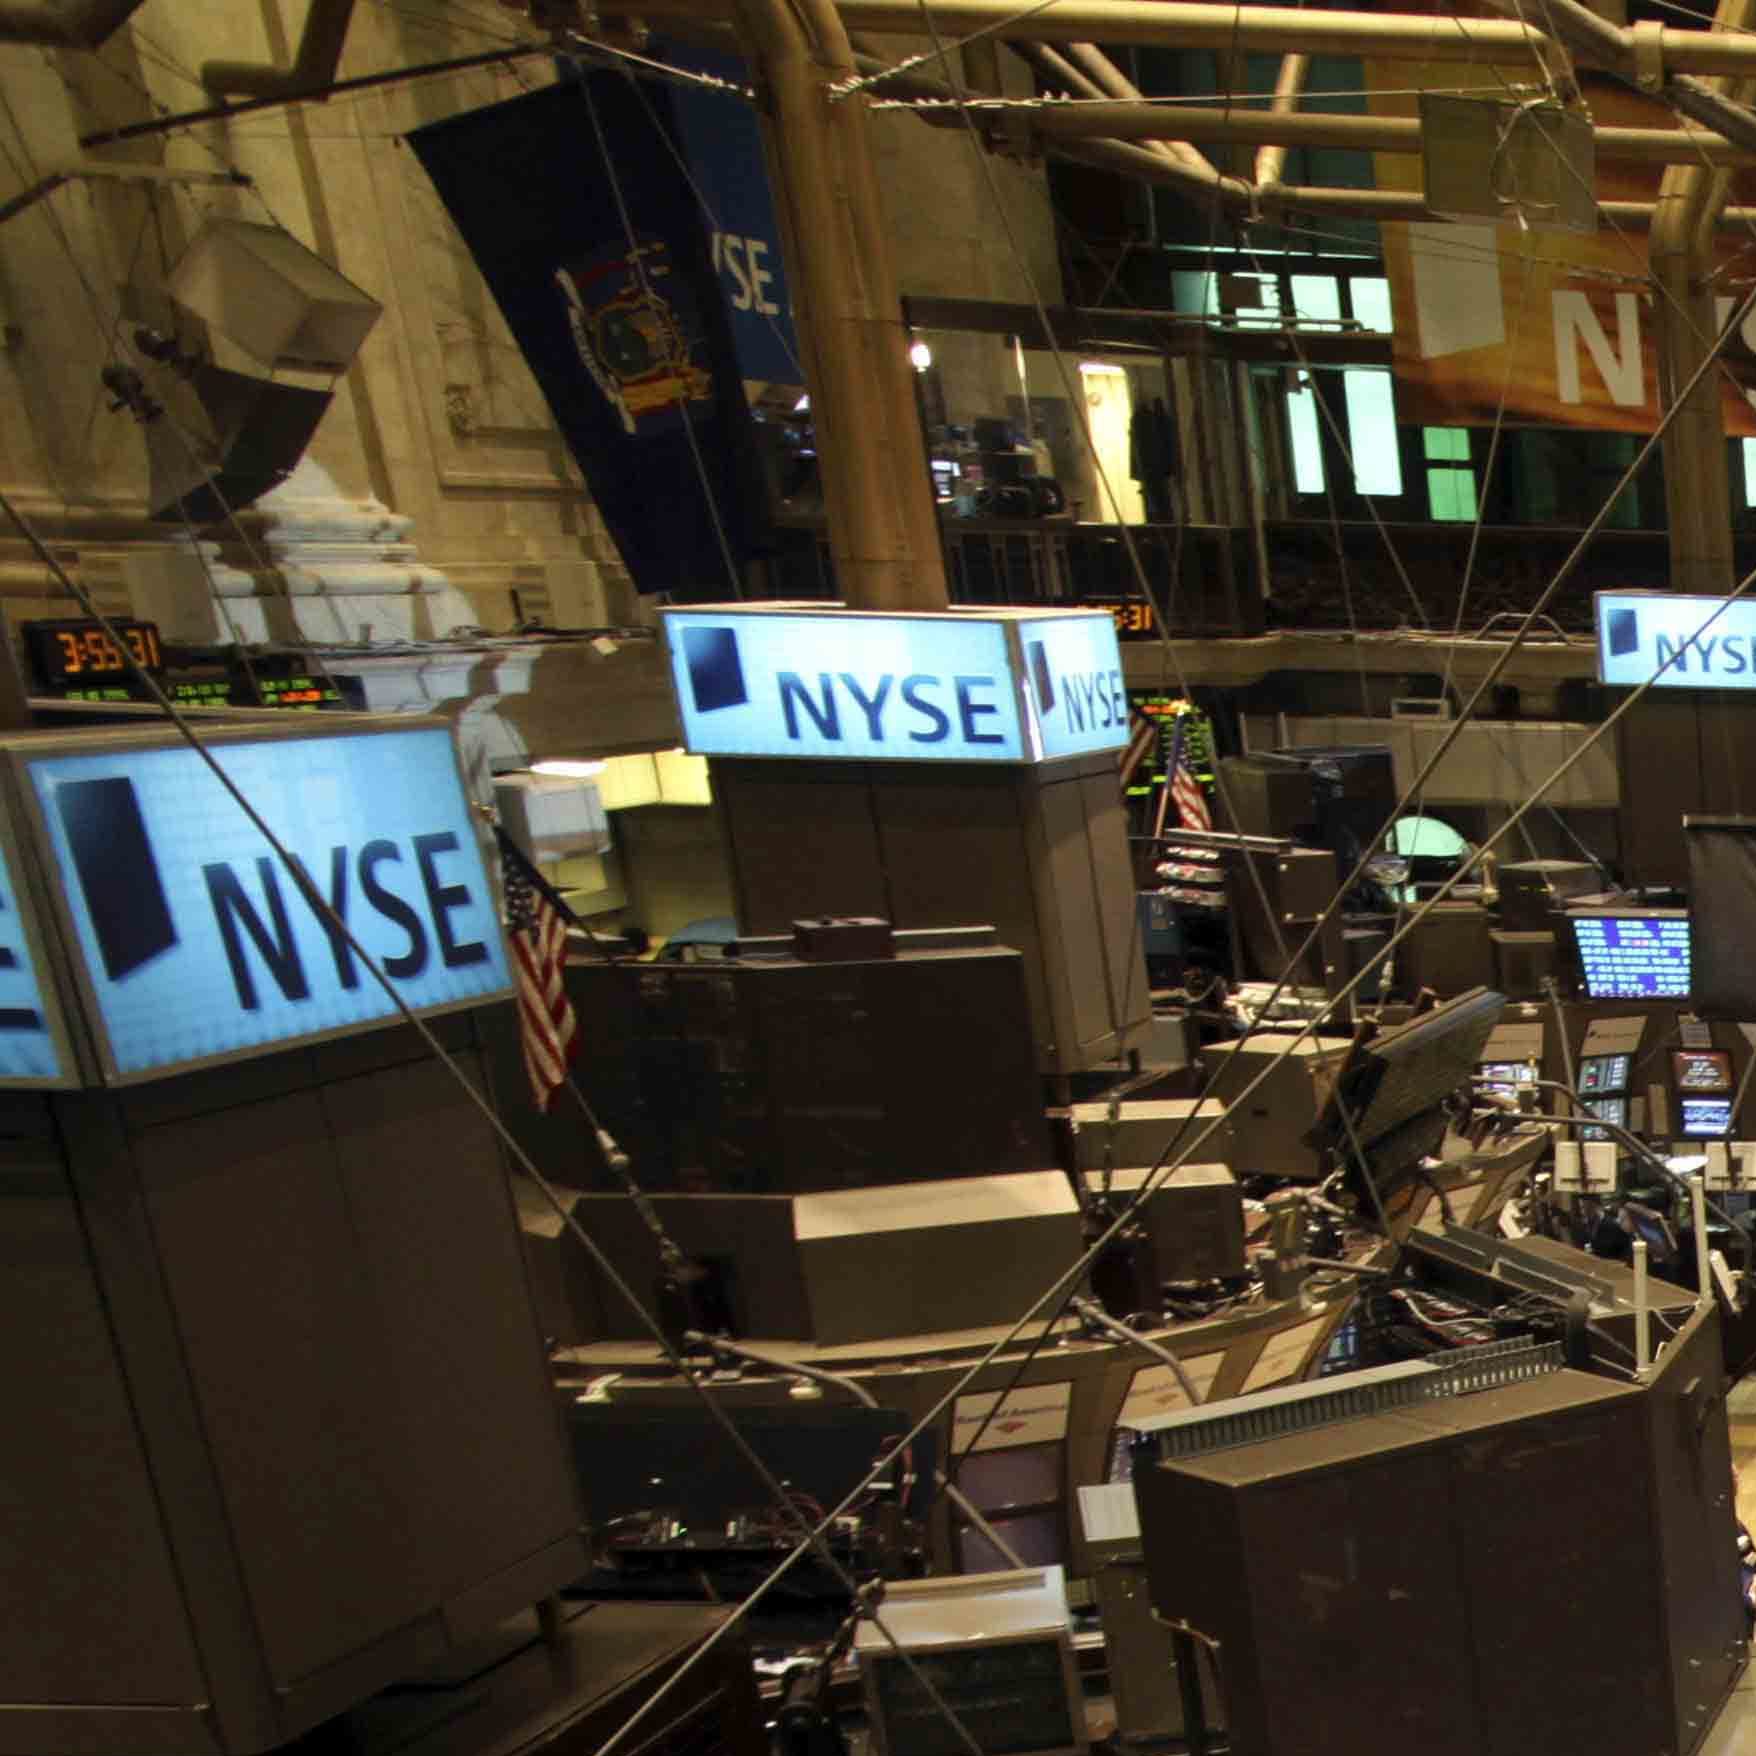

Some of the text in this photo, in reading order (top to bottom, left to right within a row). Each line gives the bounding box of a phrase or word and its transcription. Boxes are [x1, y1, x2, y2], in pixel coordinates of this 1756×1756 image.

[712, 232, 779, 315] SE
[58, 630, 161, 673] 3:5531
[776, 671, 1006, 745] NYSE
[1062, 668, 1126, 733] NYSE
[202, 831, 489, 1012] NYSE
